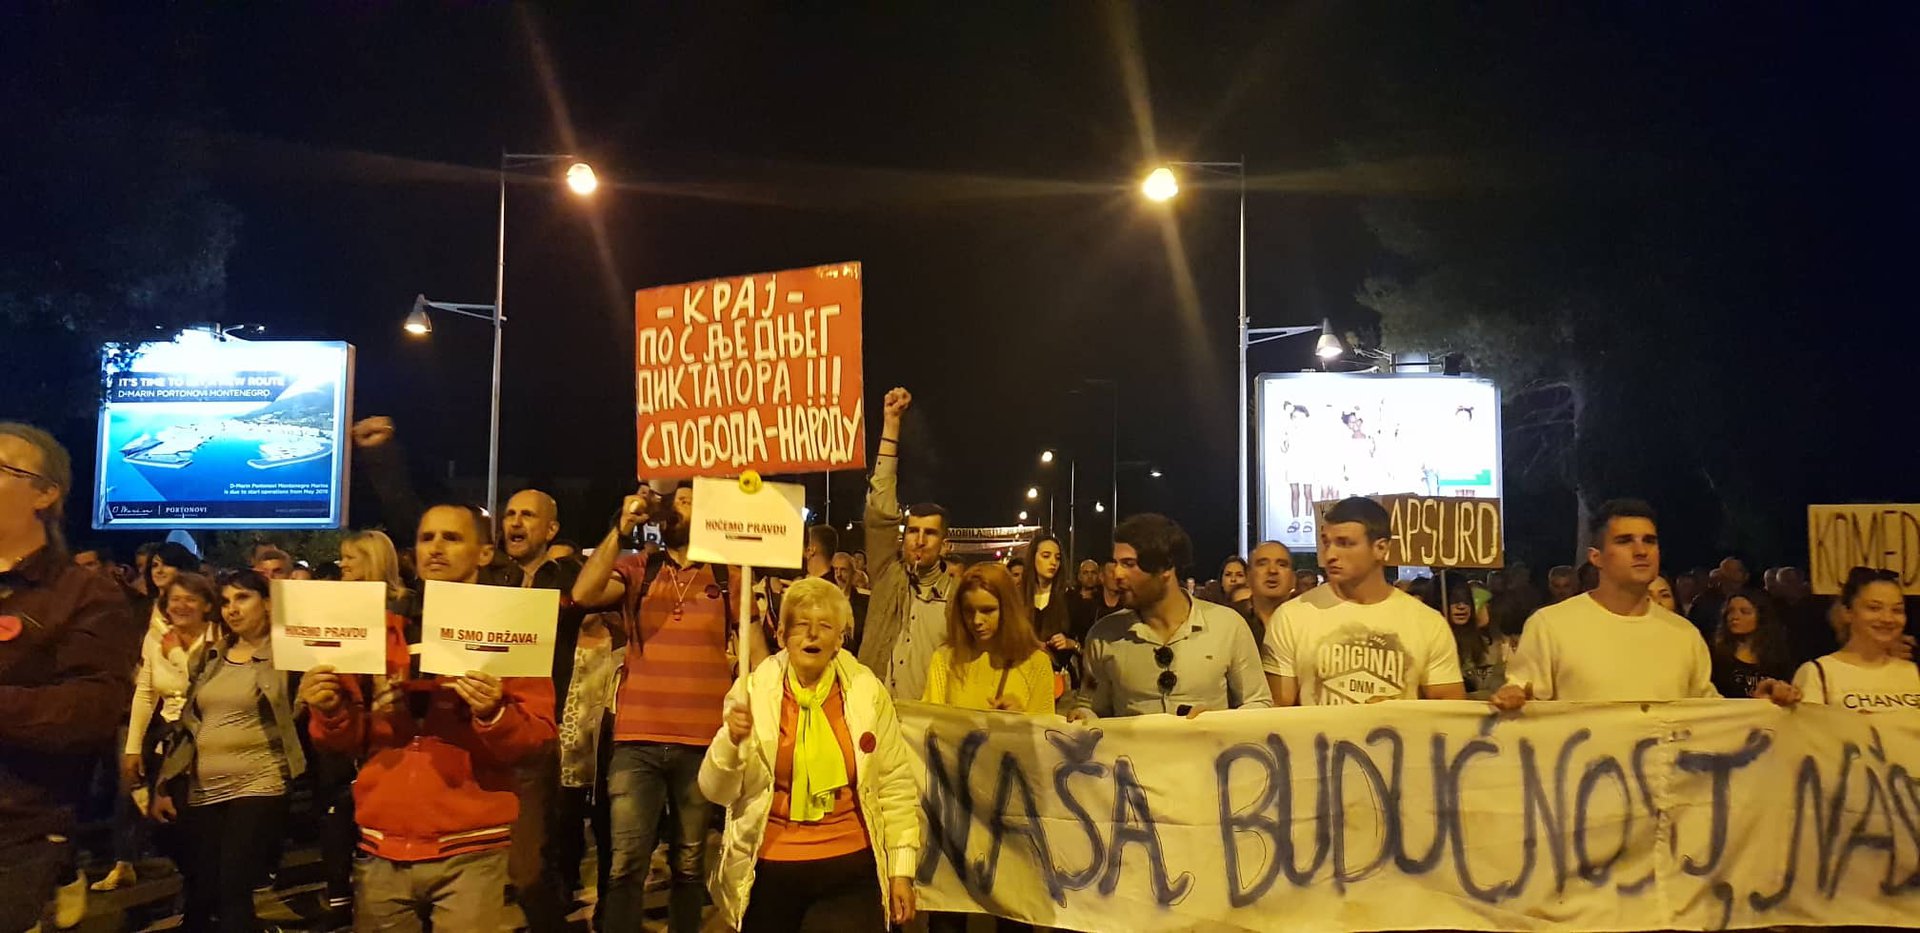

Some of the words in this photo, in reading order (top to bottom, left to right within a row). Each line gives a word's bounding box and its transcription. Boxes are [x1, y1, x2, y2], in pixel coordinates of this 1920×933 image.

[118, 390, 155, 398] D-MARIN
[209, 389, 271, 398] MONTENEGRO
[638, 359, 792, 416] ДИКТАТОРА
[747, 522, 787, 535] PRAVDU
[1384, 498, 1498, 565] APSURD
[457, 629, 483, 642] SMO
[487, 630, 538, 644] DRŽAVA!
[1318, 643, 1405, 688] ORIGINAL
[1349, 679, 1375, 694] DNM
